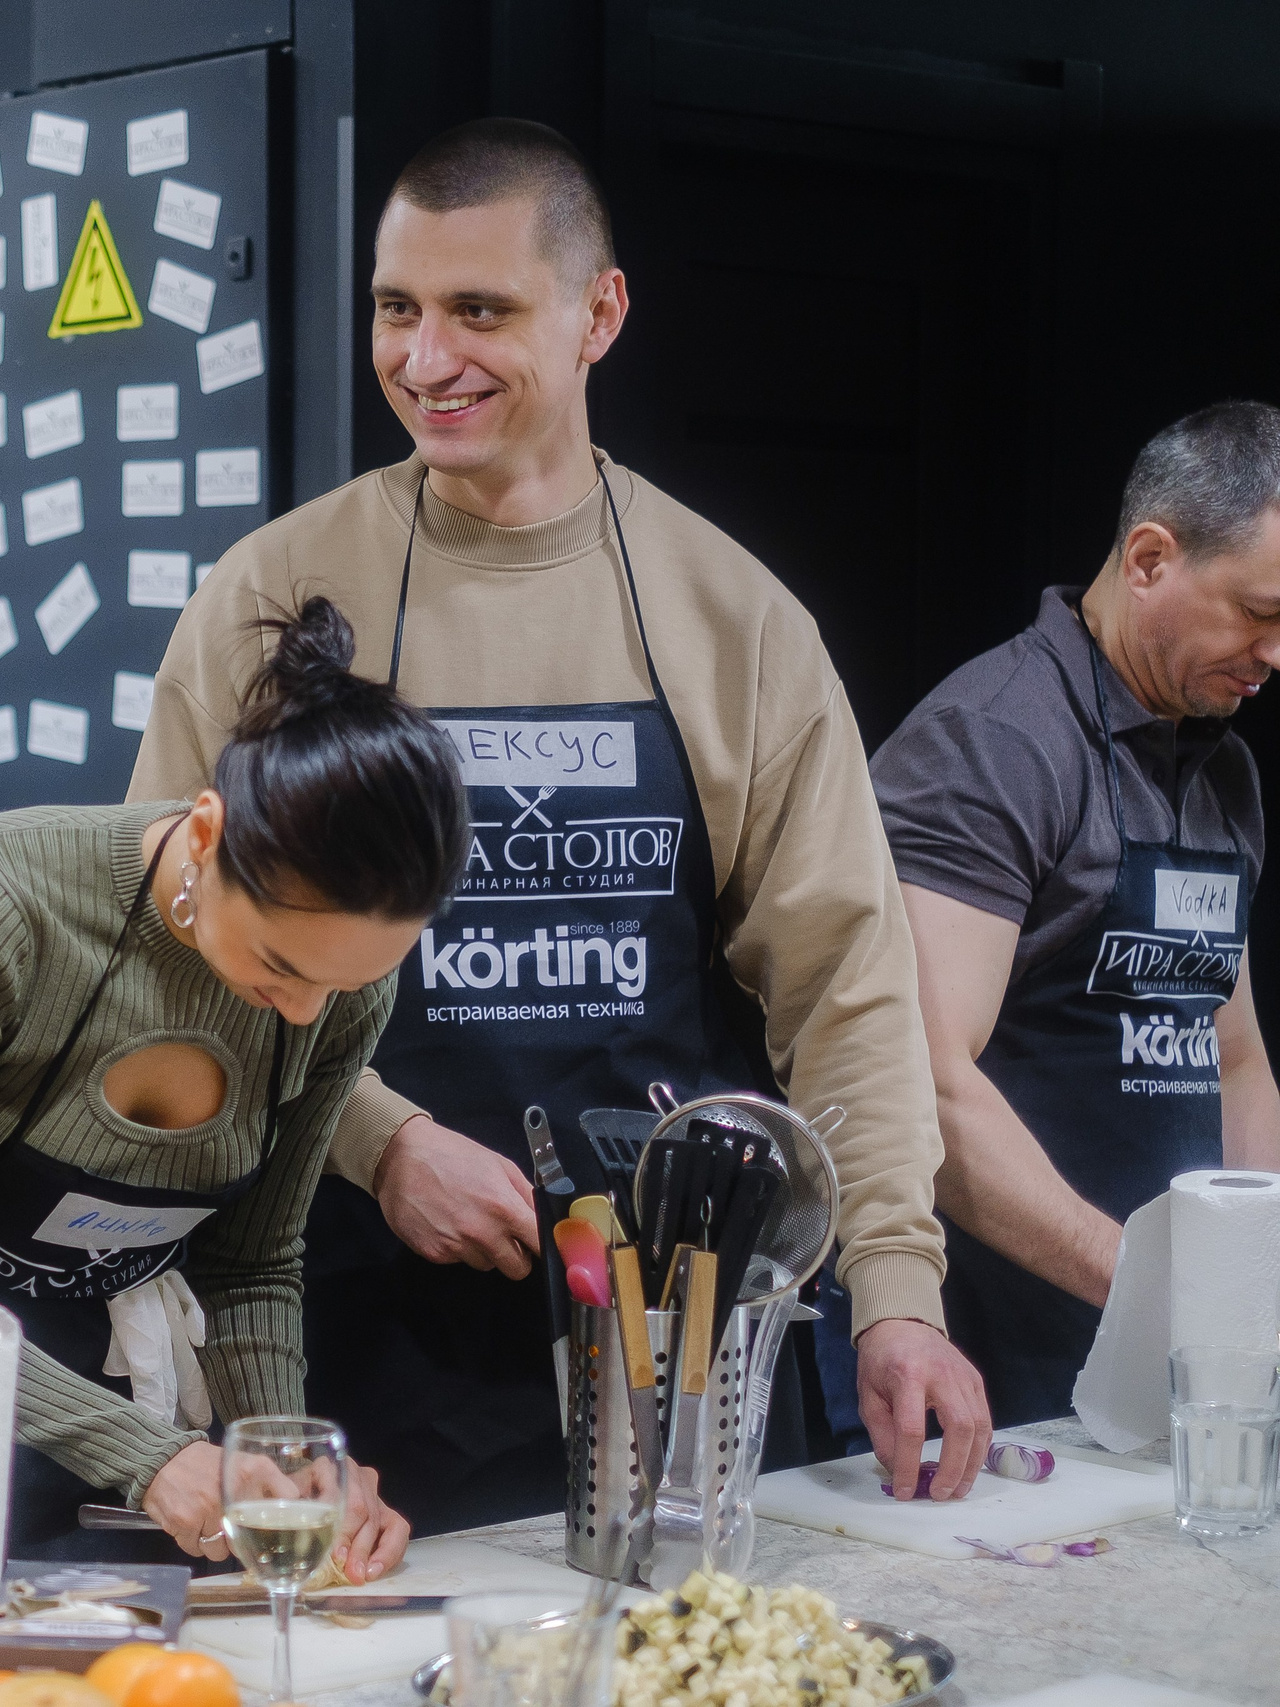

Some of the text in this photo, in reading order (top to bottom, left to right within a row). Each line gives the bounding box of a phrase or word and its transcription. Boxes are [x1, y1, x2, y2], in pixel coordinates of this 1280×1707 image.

[503, 827, 673, 872] СТОЛОВ
[454, 872, 636, 890] ИНАРНАЯ СТУДИЯ
[569, 919, 641, 935] since 1889
[420, 924, 648, 998] körting
[1105, 940, 1174, 978] ИГРА
[426, 999, 645, 1025] встраиваемая техника
[1119, 1012, 1221, 1079] körtin
[1121, 1079, 1208, 1098] встраиваемая
[101, 1253, 153, 1291] СТУДИЯ
